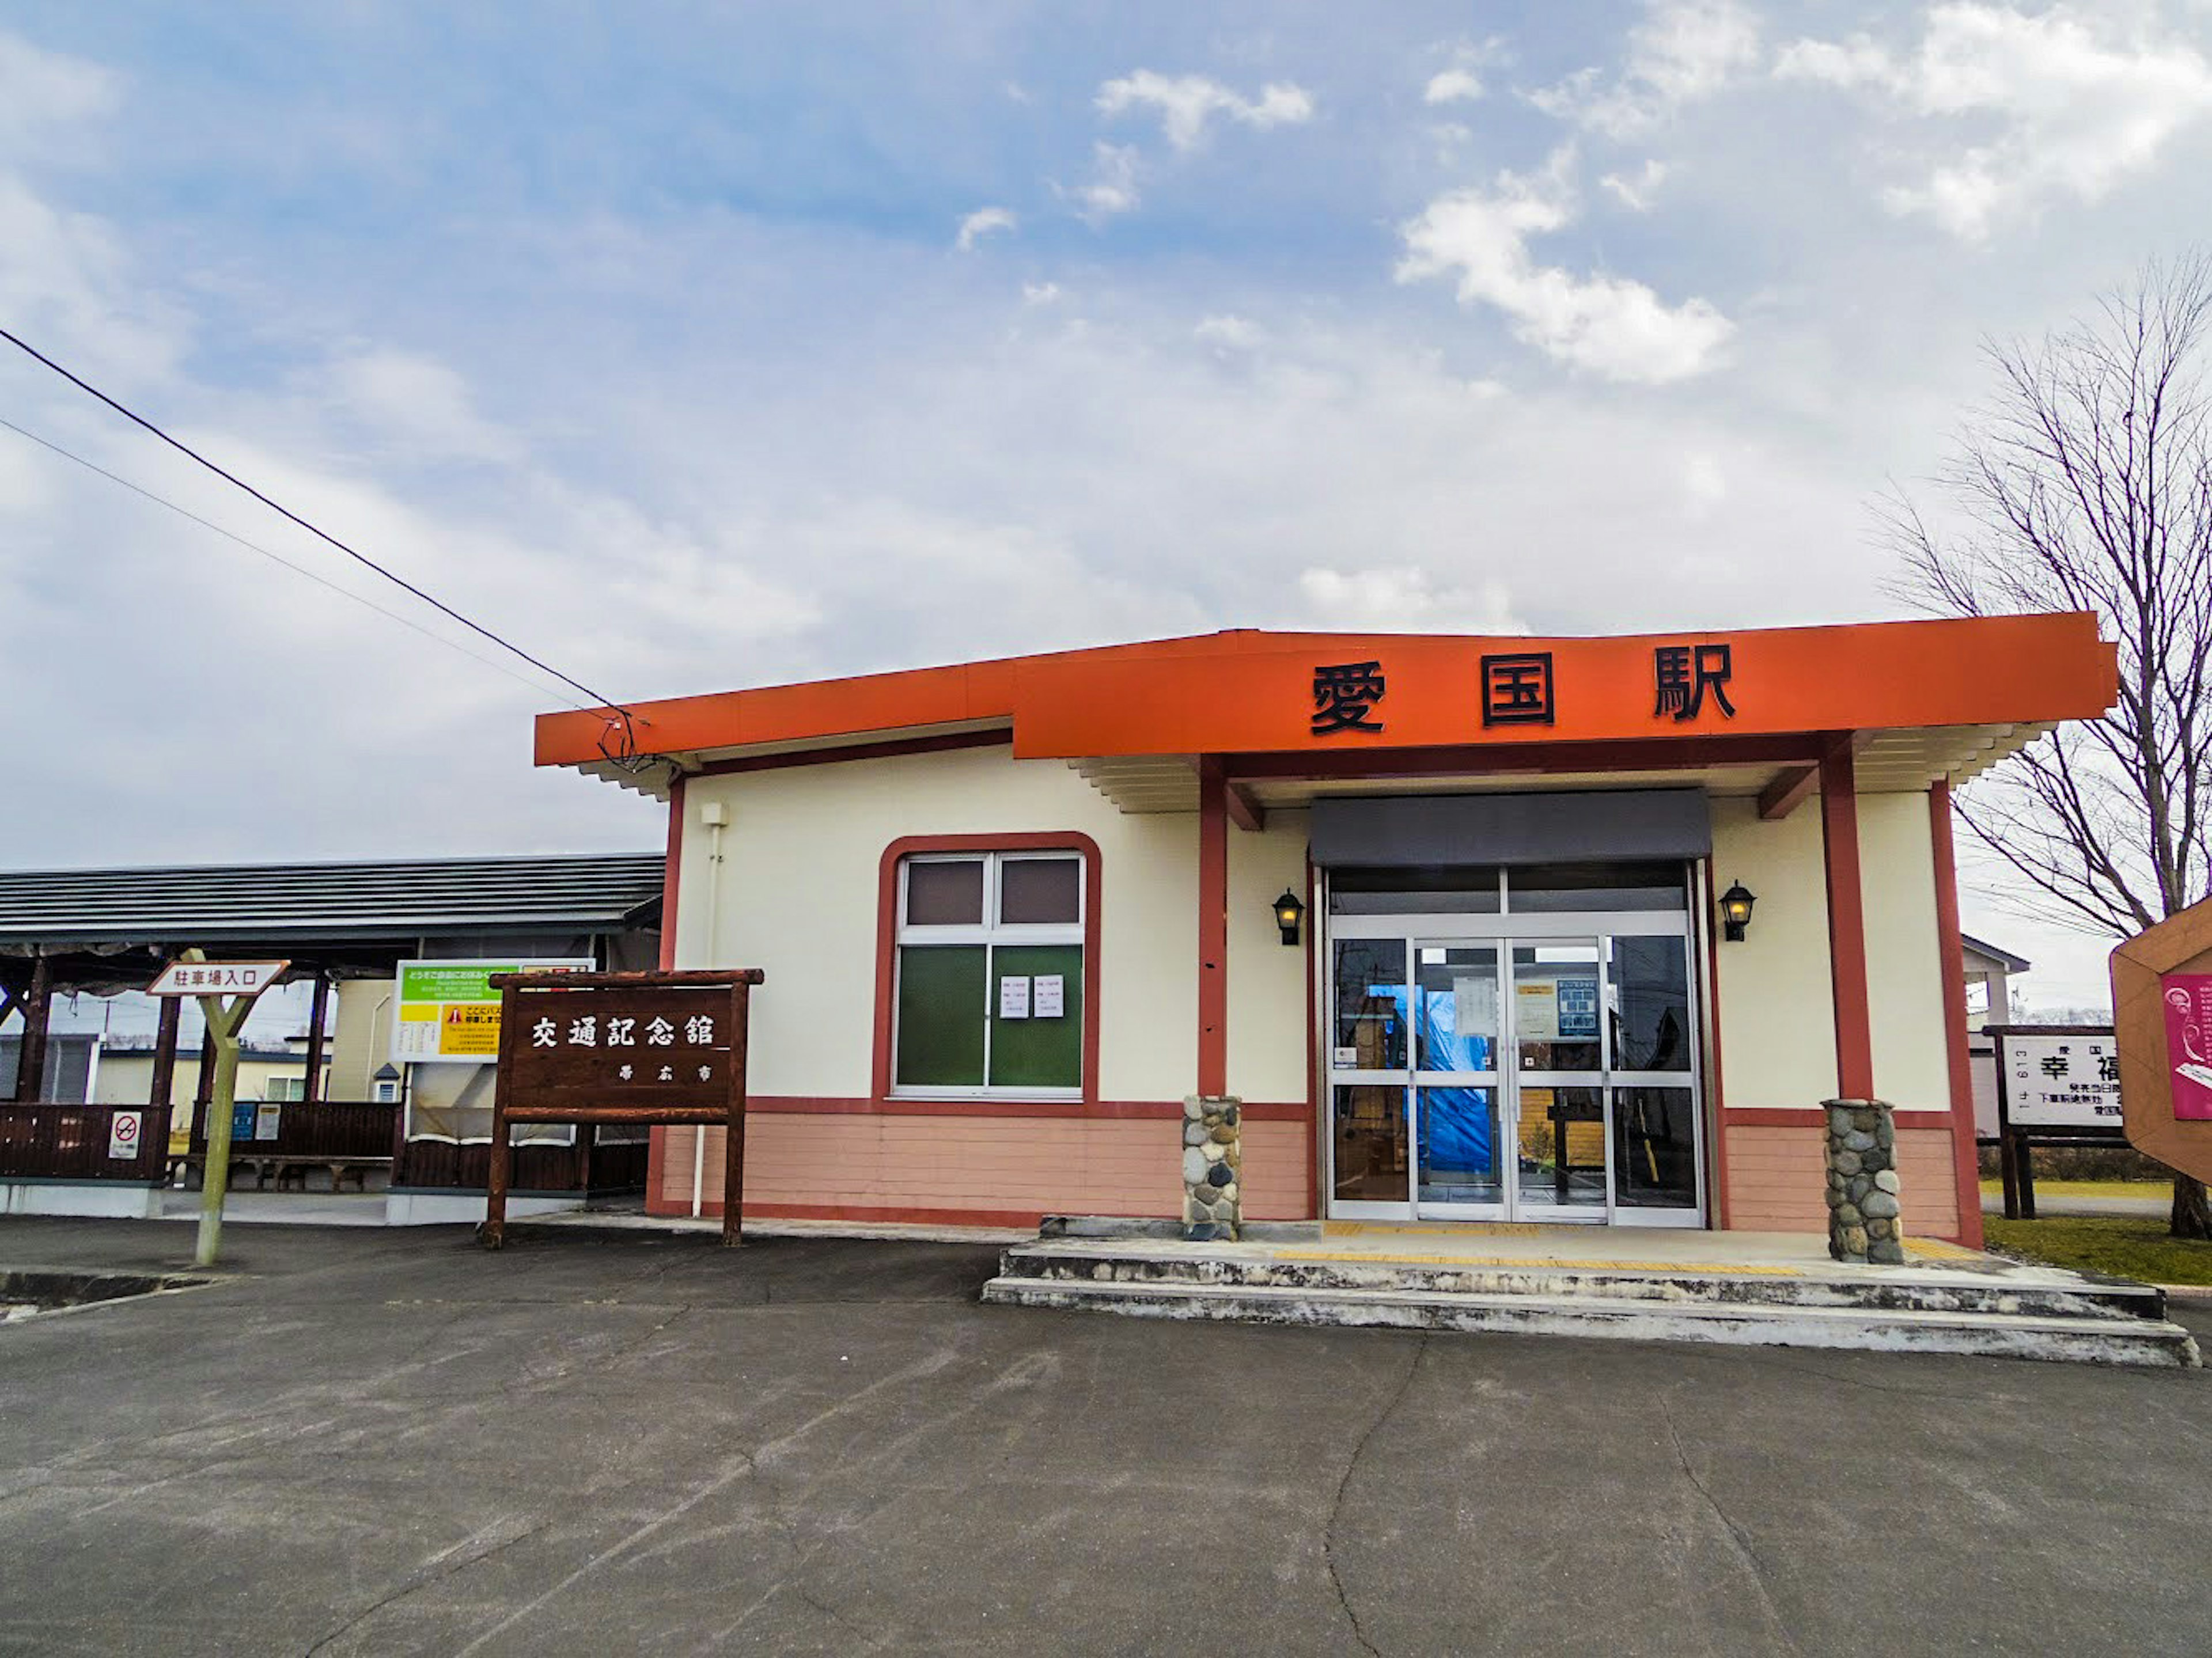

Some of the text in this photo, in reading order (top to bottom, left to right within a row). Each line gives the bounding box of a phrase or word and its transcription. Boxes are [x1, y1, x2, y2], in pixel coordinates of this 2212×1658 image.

[1311, 644, 1736, 736] 愛国駅
[175, 970, 256, 986] 駐車場入口
[2059, 1046, 2117, 1054] 愛国
[2041, 1056, 2120, 1081] 幸福
